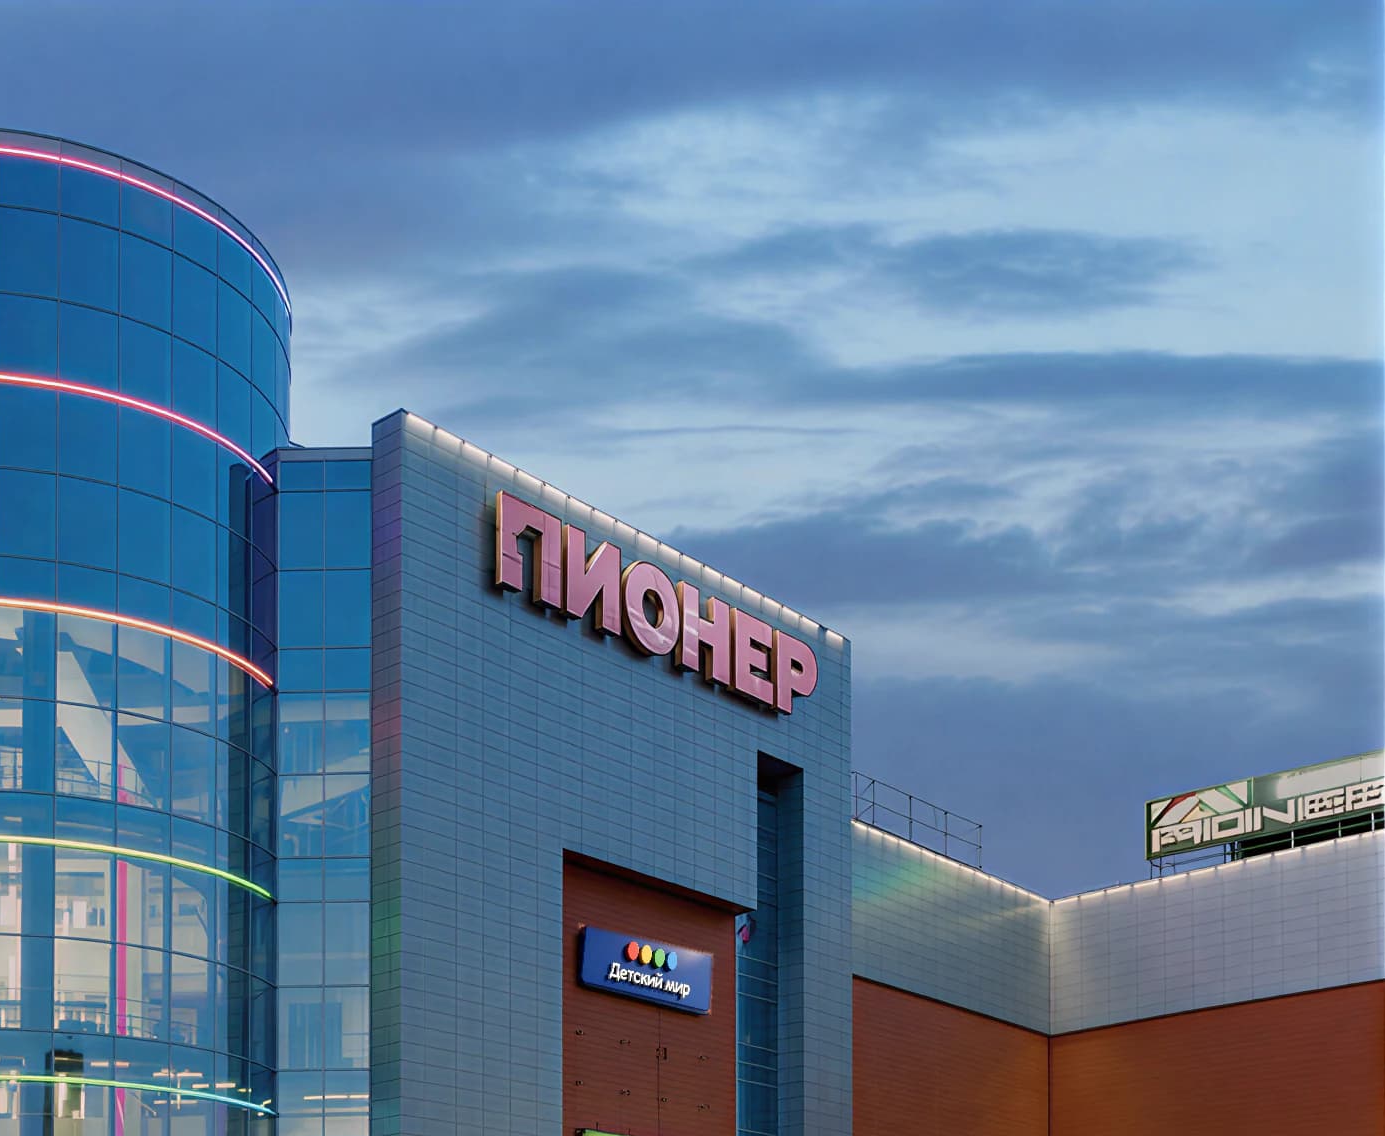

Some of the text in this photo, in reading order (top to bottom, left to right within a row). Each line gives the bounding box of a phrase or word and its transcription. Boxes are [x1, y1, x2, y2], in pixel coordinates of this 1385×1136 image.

[495, 489, 819, 715] ПИОНЕР
[609, 962, 691, 998] Детский мир
